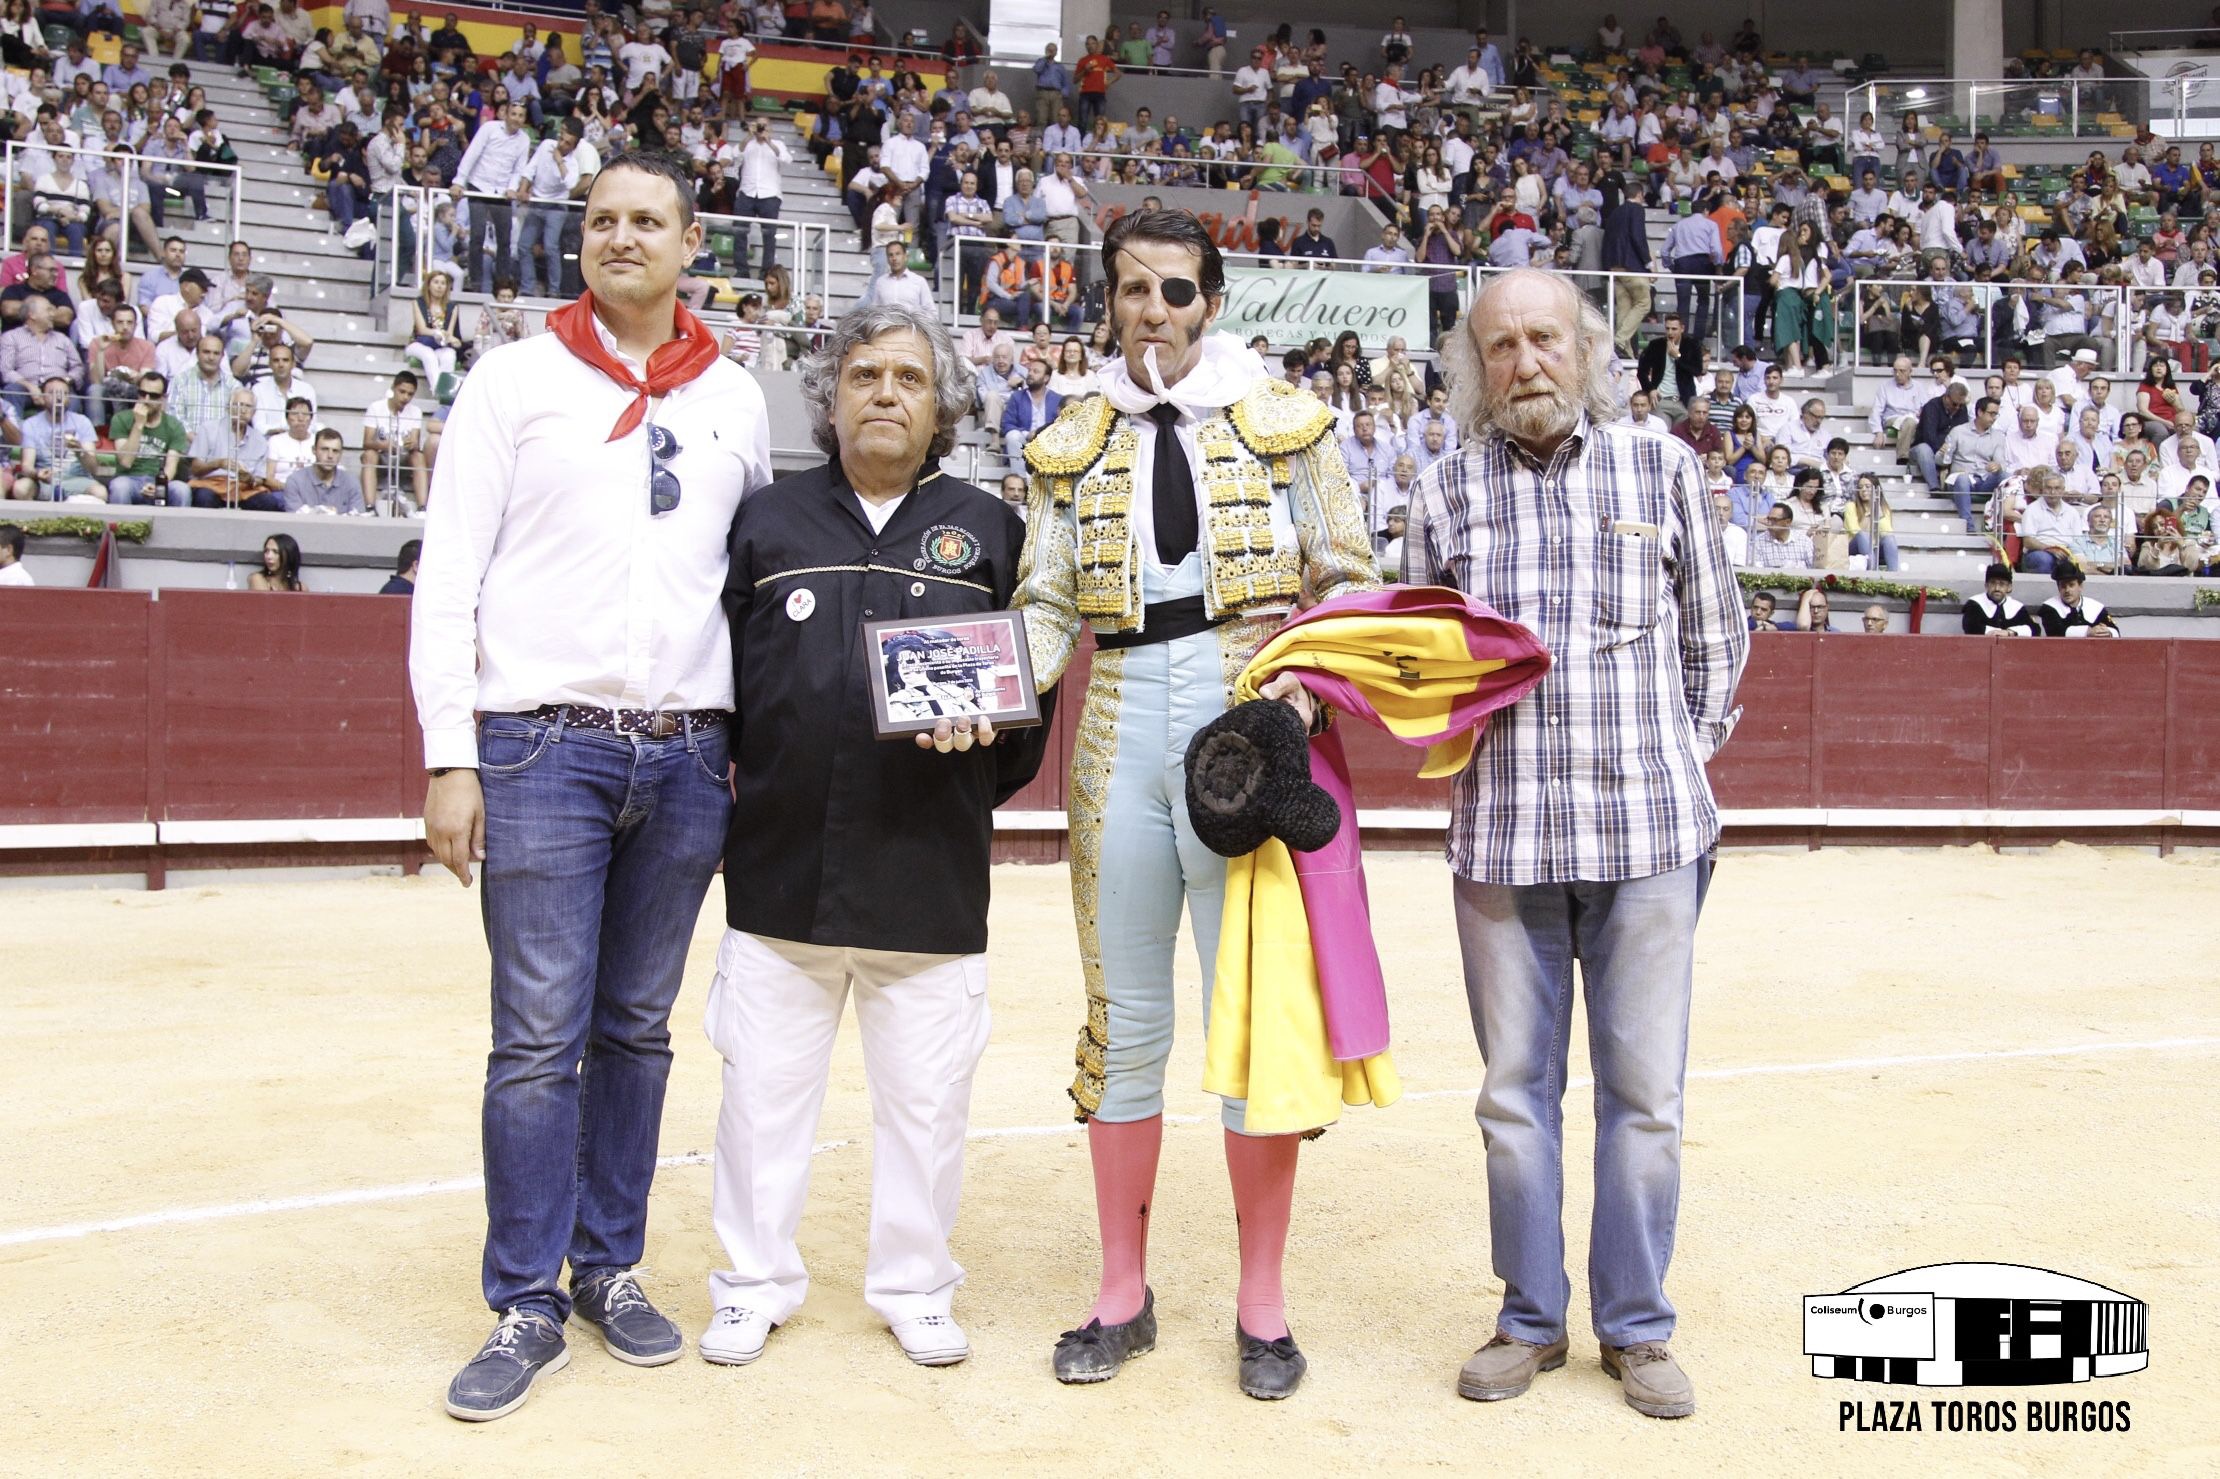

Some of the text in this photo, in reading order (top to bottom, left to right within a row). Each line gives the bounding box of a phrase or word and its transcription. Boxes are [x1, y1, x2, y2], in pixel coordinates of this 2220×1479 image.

[1216, 275, 1407, 328] Valduero
[1235, 327, 1303, 339] BODEGAS
[1309, 331, 1318, 340] Y
[932, 564, 961, 574] BURGOS
[793, 598, 812, 617] CLARA
[927, 647, 953, 659] JOSÉ
[956, 644, 1001, 656] PADILLA
